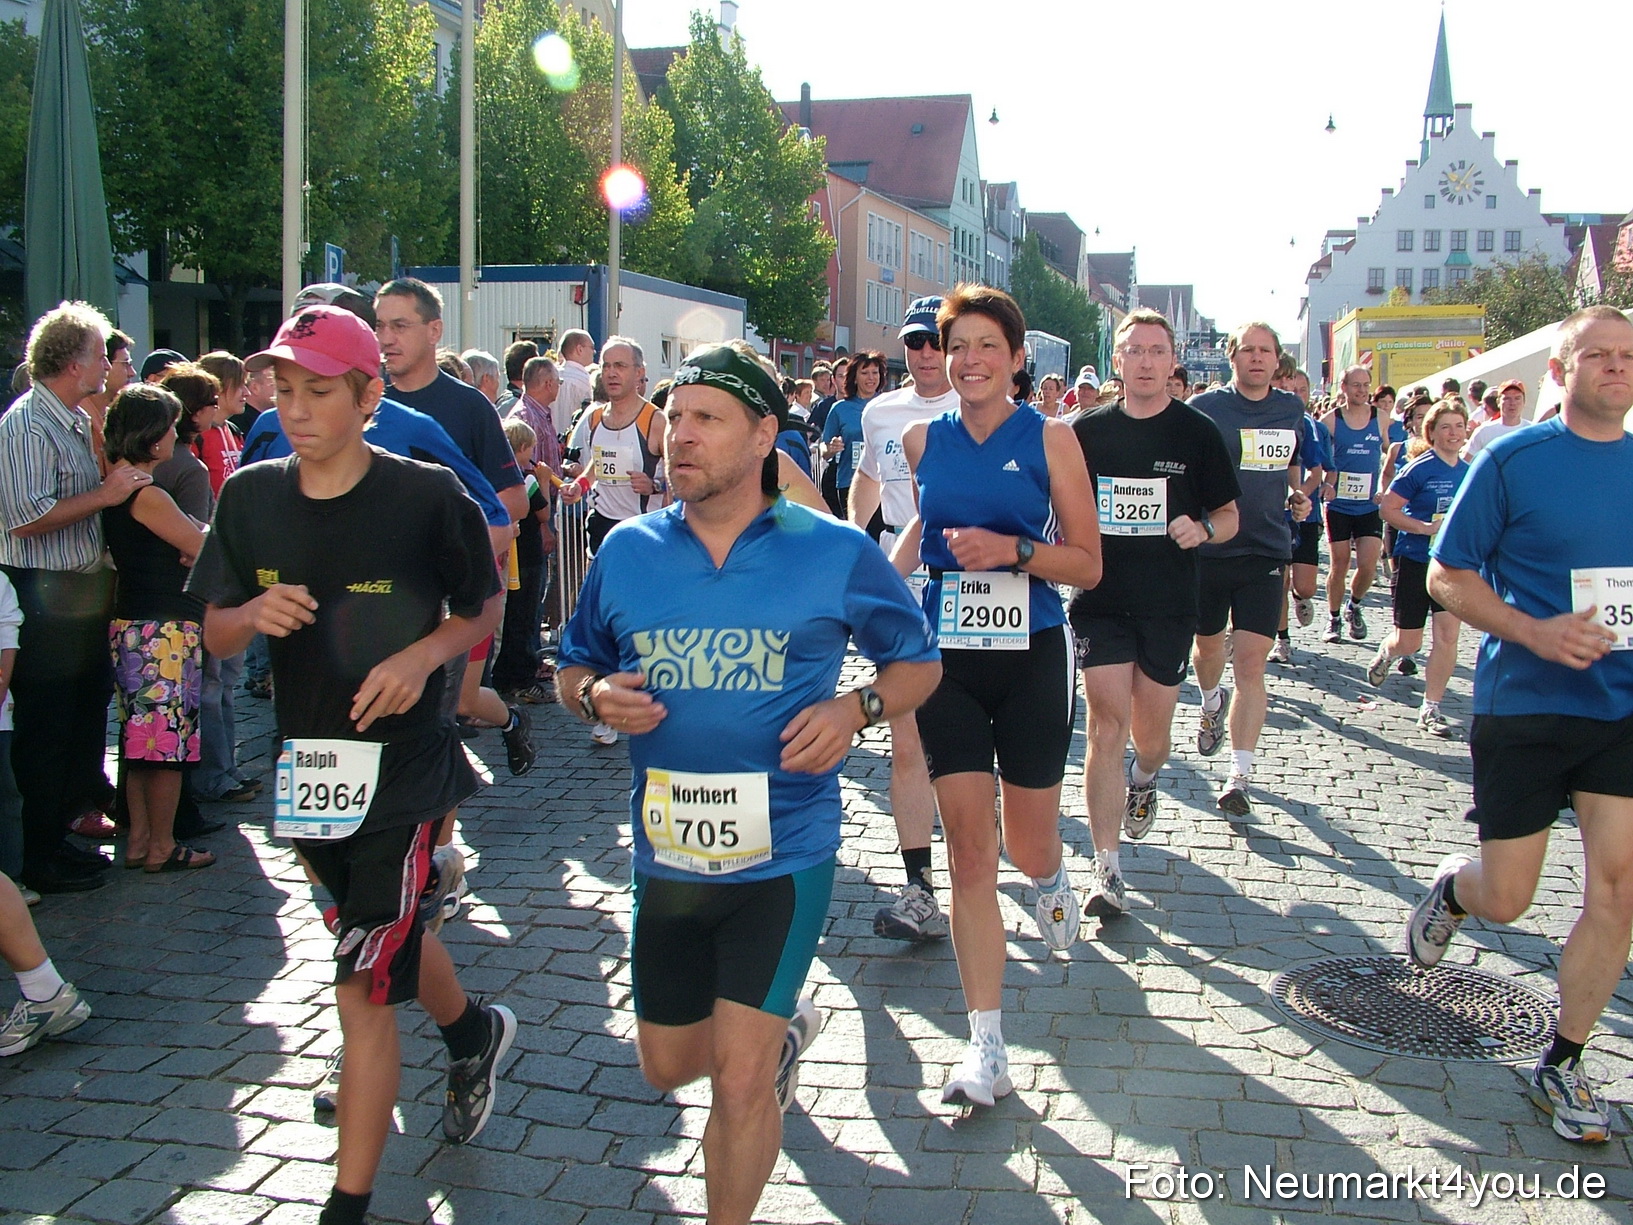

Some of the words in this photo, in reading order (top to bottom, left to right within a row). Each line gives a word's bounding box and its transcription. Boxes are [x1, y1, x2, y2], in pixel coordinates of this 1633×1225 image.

[329, 251, 339, 283] P
[1258, 429, 1281, 437] Robby
[1258, 444, 1291, 458] 1053
[602, 463, 616, 475] 26
[1113, 484, 1155, 497] Andreas
[1347, 484, 1364, 493] 737
[1100, 499, 1108, 508] C
[1115, 503, 1162, 520] 3267
[960, 579, 992, 595] Erika
[944, 600, 953, 613] C
[961, 605, 1023, 628] 2900
[1604, 604, 1633, 626] 35
[295, 750, 338, 770] Ralph
[280, 776, 288, 791] D
[297, 782, 368, 811] 2964
[671, 783, 738, 806] Norbert
[650, 809, 662, 826] D
[674, 819, 740, 848] 705
